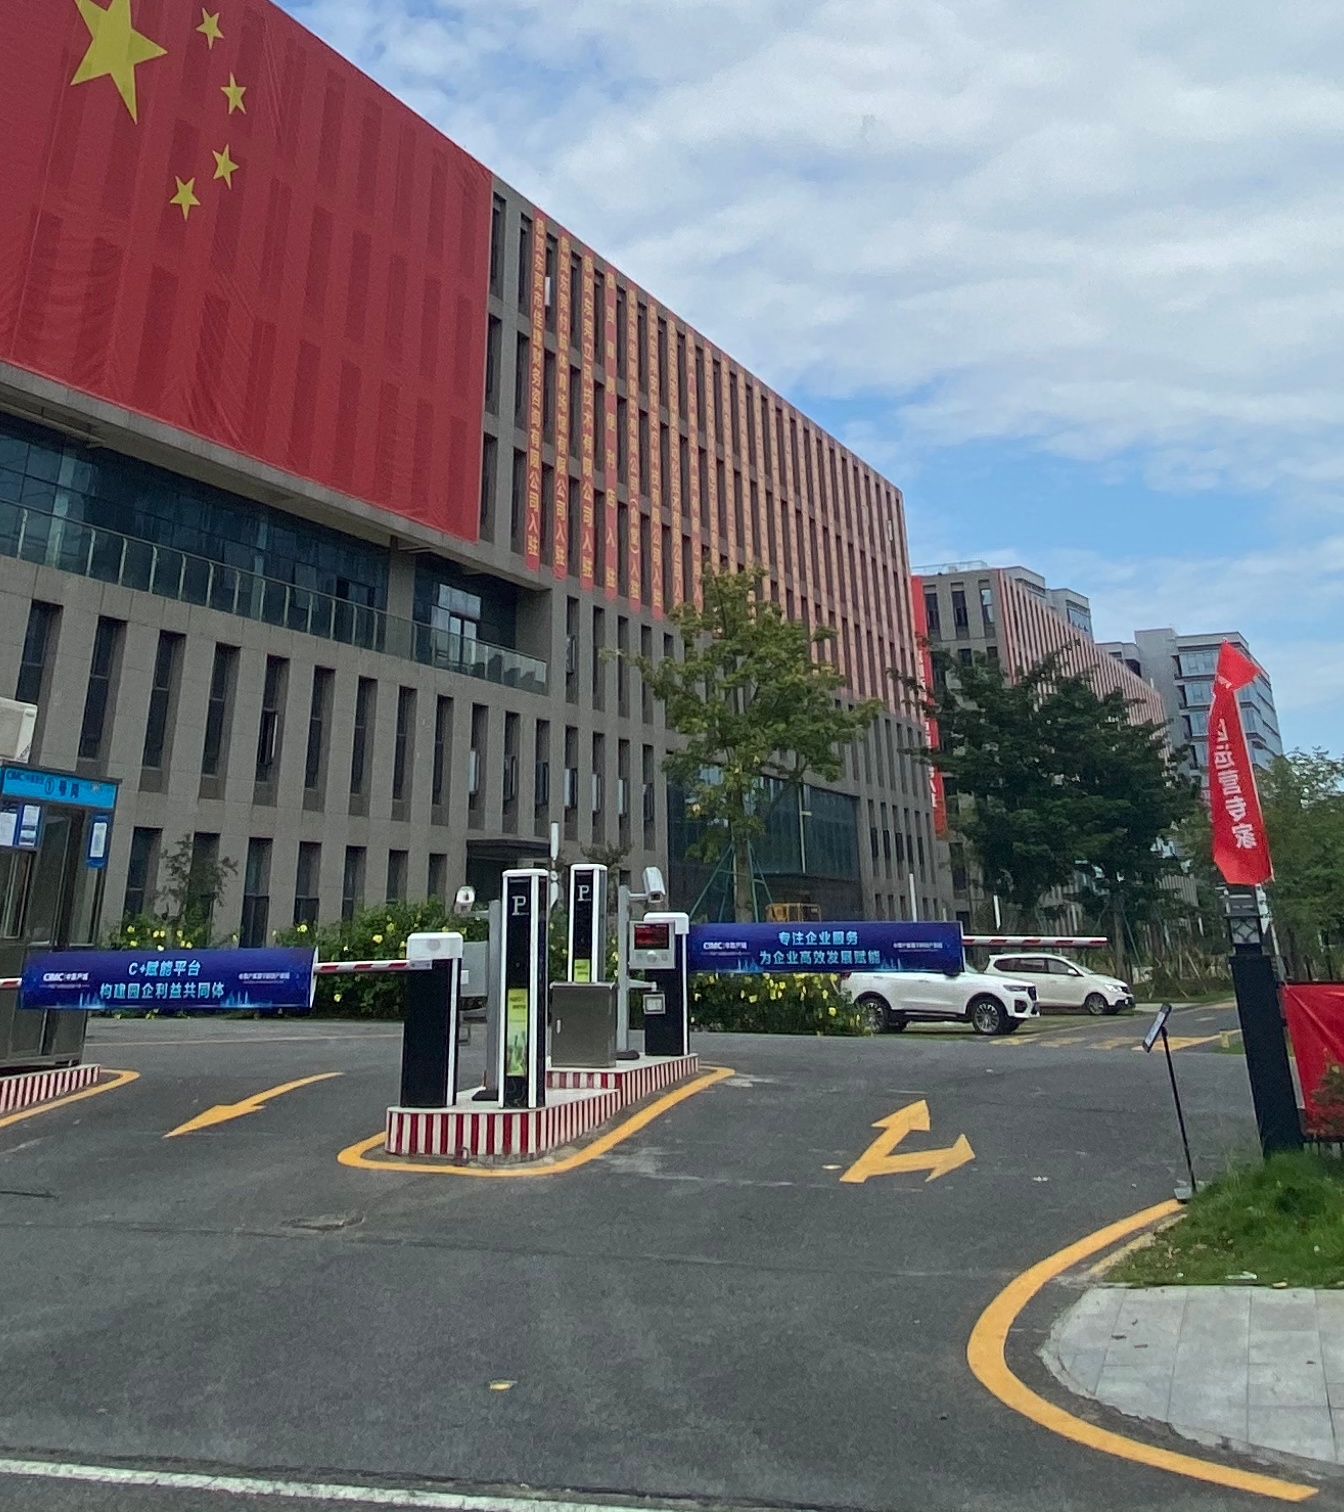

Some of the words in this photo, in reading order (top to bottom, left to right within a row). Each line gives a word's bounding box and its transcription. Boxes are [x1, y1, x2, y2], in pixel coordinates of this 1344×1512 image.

[577, 885, 592, 902] P
[511, 895, 529, 916] P
[778, 930, 859, 947] 专注企业服务
[758, 949, 881, 966] 为企业高效发展赋能
[99, 981, 226, 1001] 构建园企利益共同体
